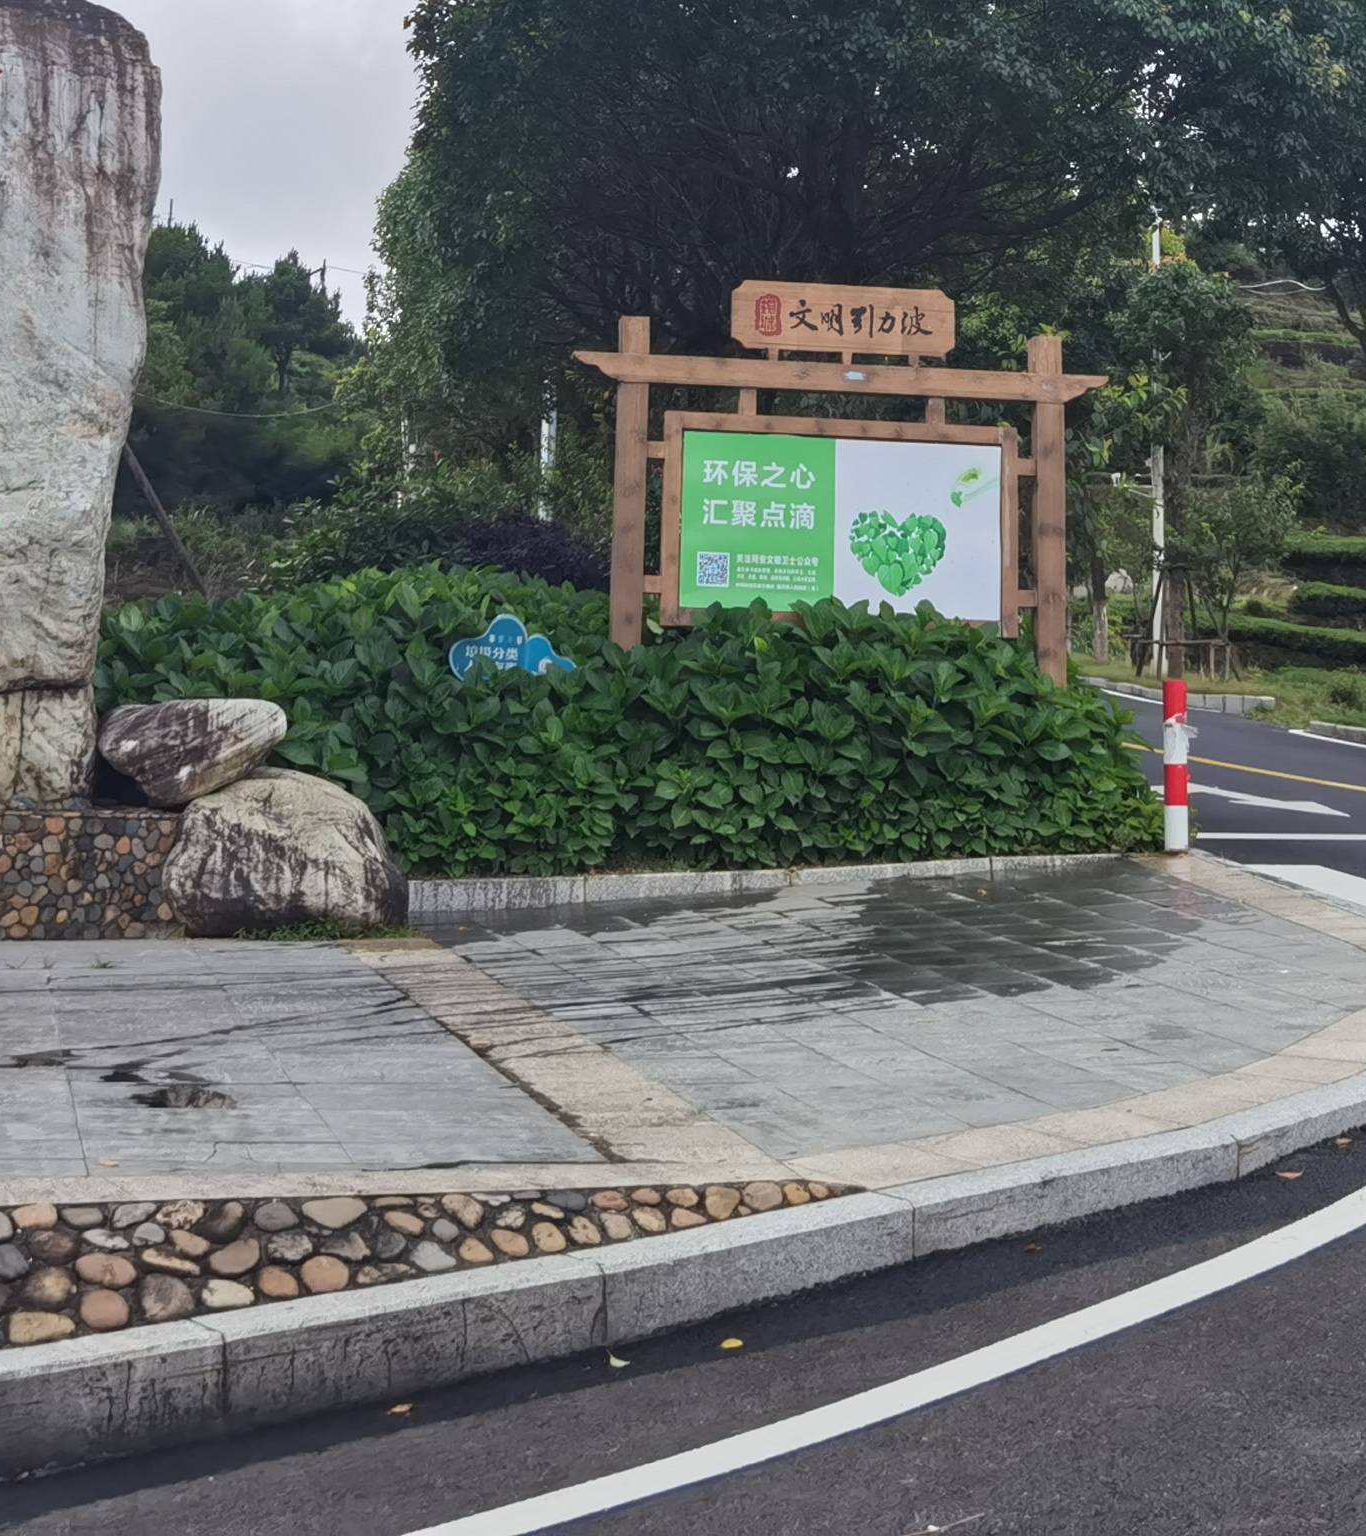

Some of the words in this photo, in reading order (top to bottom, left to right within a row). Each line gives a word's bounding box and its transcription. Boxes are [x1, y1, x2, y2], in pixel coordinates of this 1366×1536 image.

[789, 299, 933, 338] 文明引力波
[702, 459, 816, 490] 环保之心
[702, 498, 816, 530] 汇聚点滴
